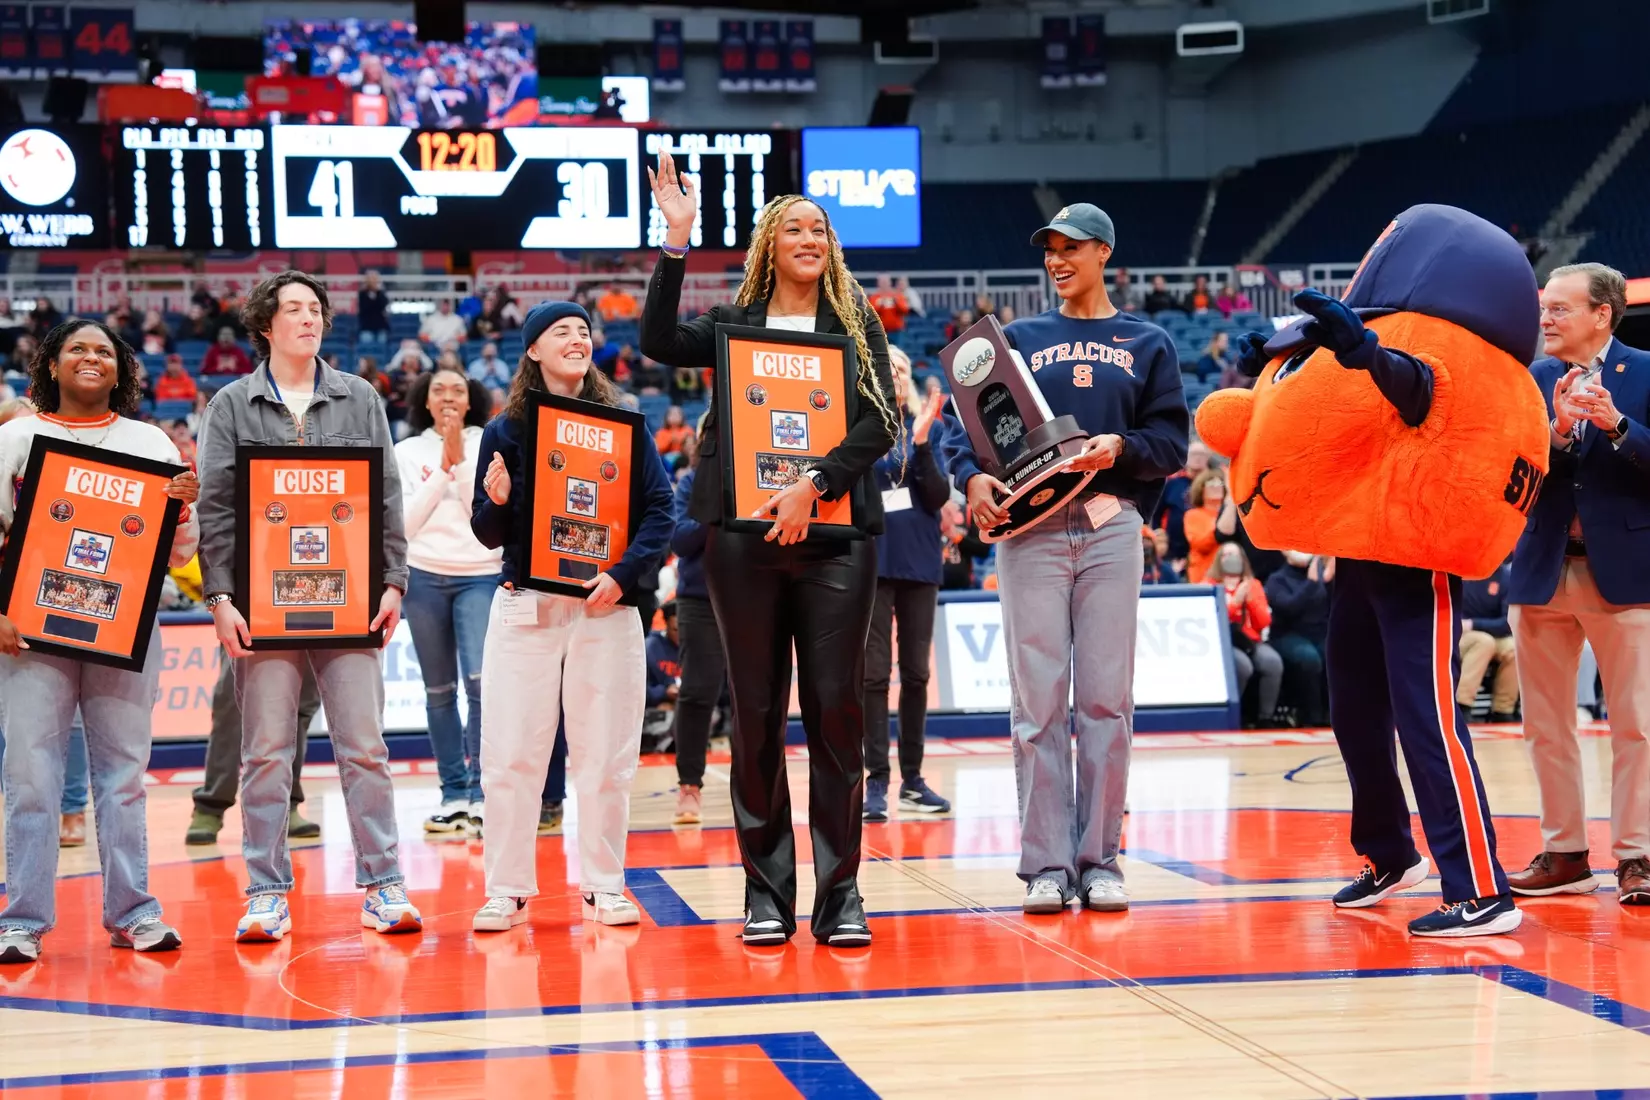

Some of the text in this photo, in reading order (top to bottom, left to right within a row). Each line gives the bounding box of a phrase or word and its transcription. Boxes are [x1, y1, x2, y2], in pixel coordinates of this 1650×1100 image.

[75, 22, 130, 55] 44
[417, 131, 497, 172] 12:20
[308, 160, 354, 218] 41
[557, 162, 609, 218] 30
[756, 353, 814, 379] 'CUSE
[957, 348, 993, 384] NCAA
[1031, 342, 1136, 377] SYRACUSE
[1073, 364, 1093, 387] S
[560, 420, 608, 451] 'CUSE
[277, 471, 338, 493] 'CUSE
[1014, 450, 1054, 482] RUNNER-UP
[73, 469, 138, 504] 'CUSE
